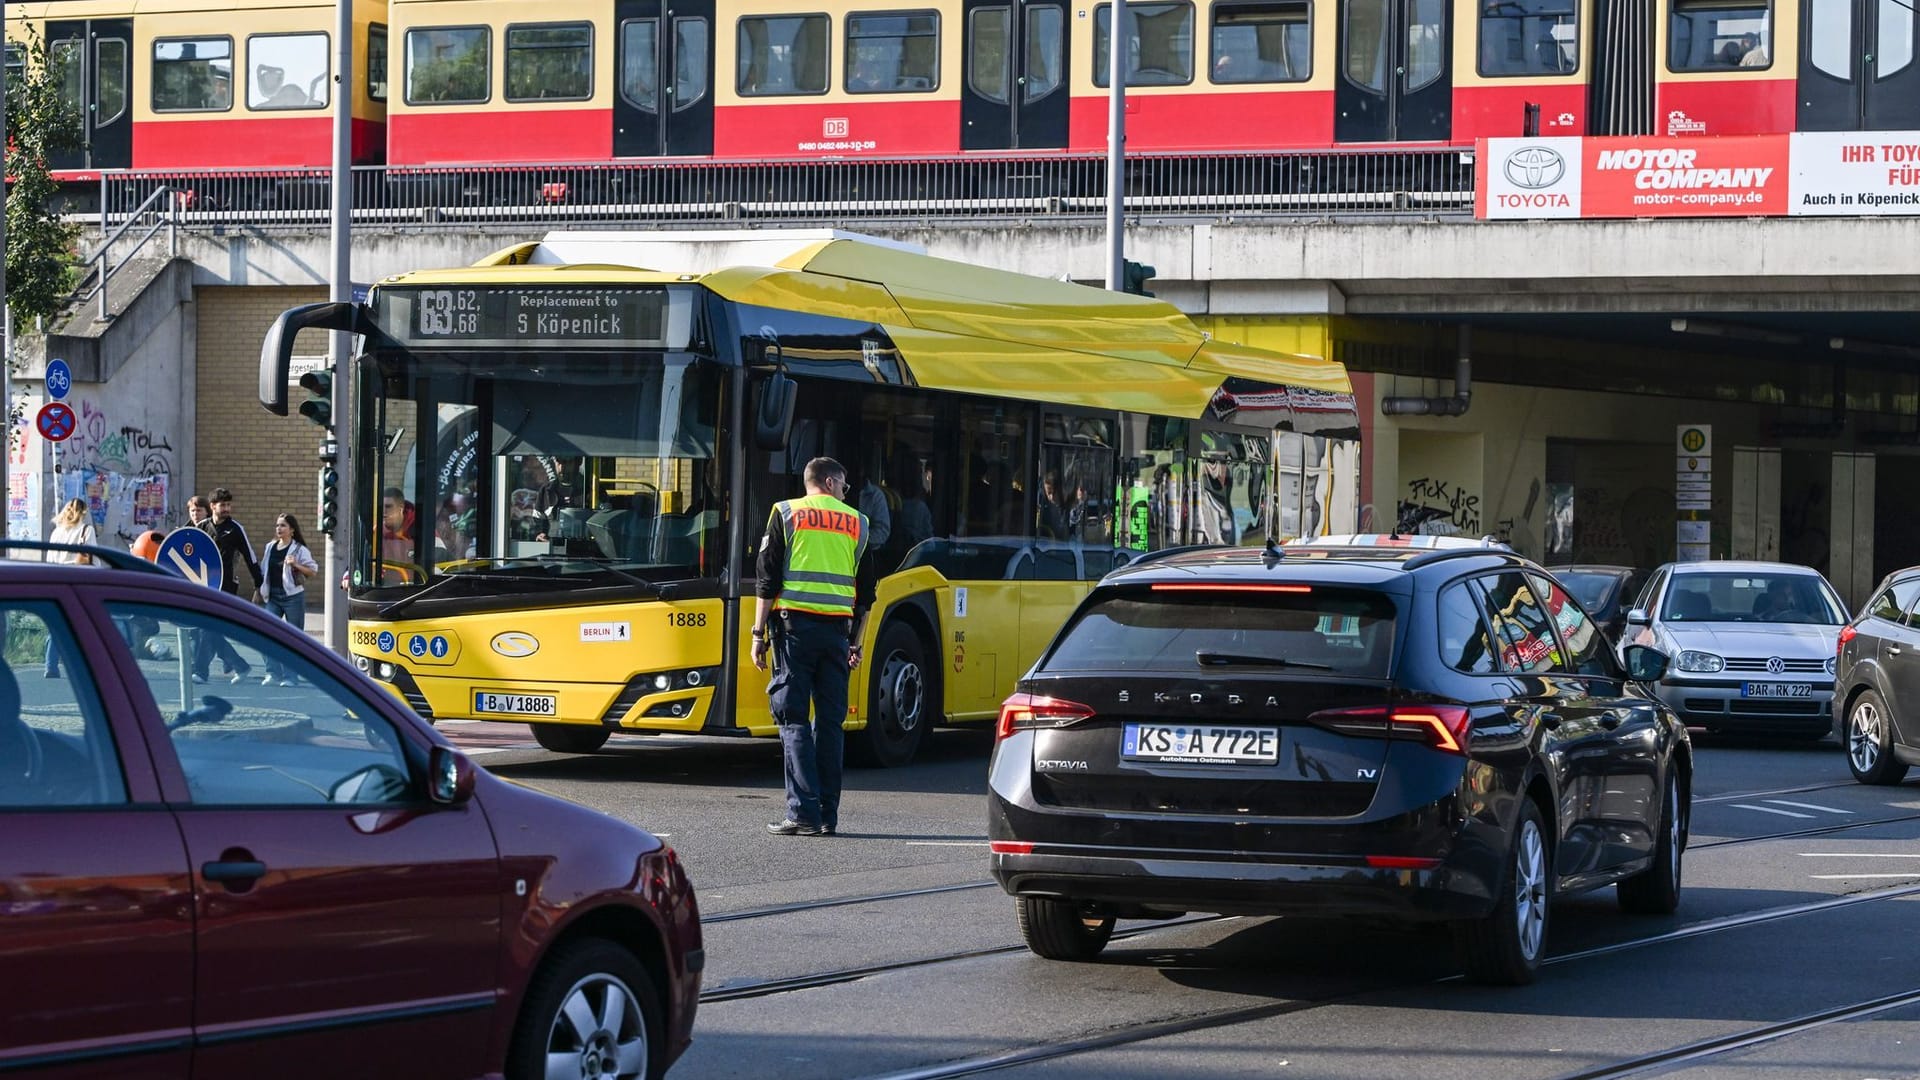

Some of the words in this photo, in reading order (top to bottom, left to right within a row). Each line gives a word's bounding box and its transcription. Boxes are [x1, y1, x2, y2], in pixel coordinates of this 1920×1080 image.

[1596, 148, 1697, 170] MOTOR
[1842, 146, 1874, 162] IHR
[1881, 145, 1920, 162] TOY
[1634, 168, 1774, 189] COMPANY
[1497, 194, 1570, 208] TOYOTA
[1634, 192, 1763, 206] motor-company.de
[1803, 193, 1836, 205] Auch
[1841, 193, 1852, 204] in
[1858, 192, 1920, 206] Köpenick
[520, 296, 600, 308] Replacement
[605, 296, 618, 306] to
[518, 314, 528, 334] S
[537, 314, 620, 334] Köpenick
[454, 446, 476, 477] WURST
[796, 509, 857, 536] POLIZEI
[668, 612, 706, 626] 1888
[352, 632, 377, 646] 1888
[584, 627, 610, 637] BERLIN
[1748, 684, 1768, 696] BAR
[1776, 684, 1788, 696] RK
[1792, 685, 1810, 696] 222
[488, 696, 496, 710] B
[506, 696, 514, 710] V
[517, 697, 550, 712] 1888
[1118, 690, 1278, 706] ŠKODA
[1138, 727, 1172, 752] KS
[1188, 728, 1204, 753] A
[1210, 729, 1274, 756] 772E
[1038, 760, 1088, 770] OCTAVIA
